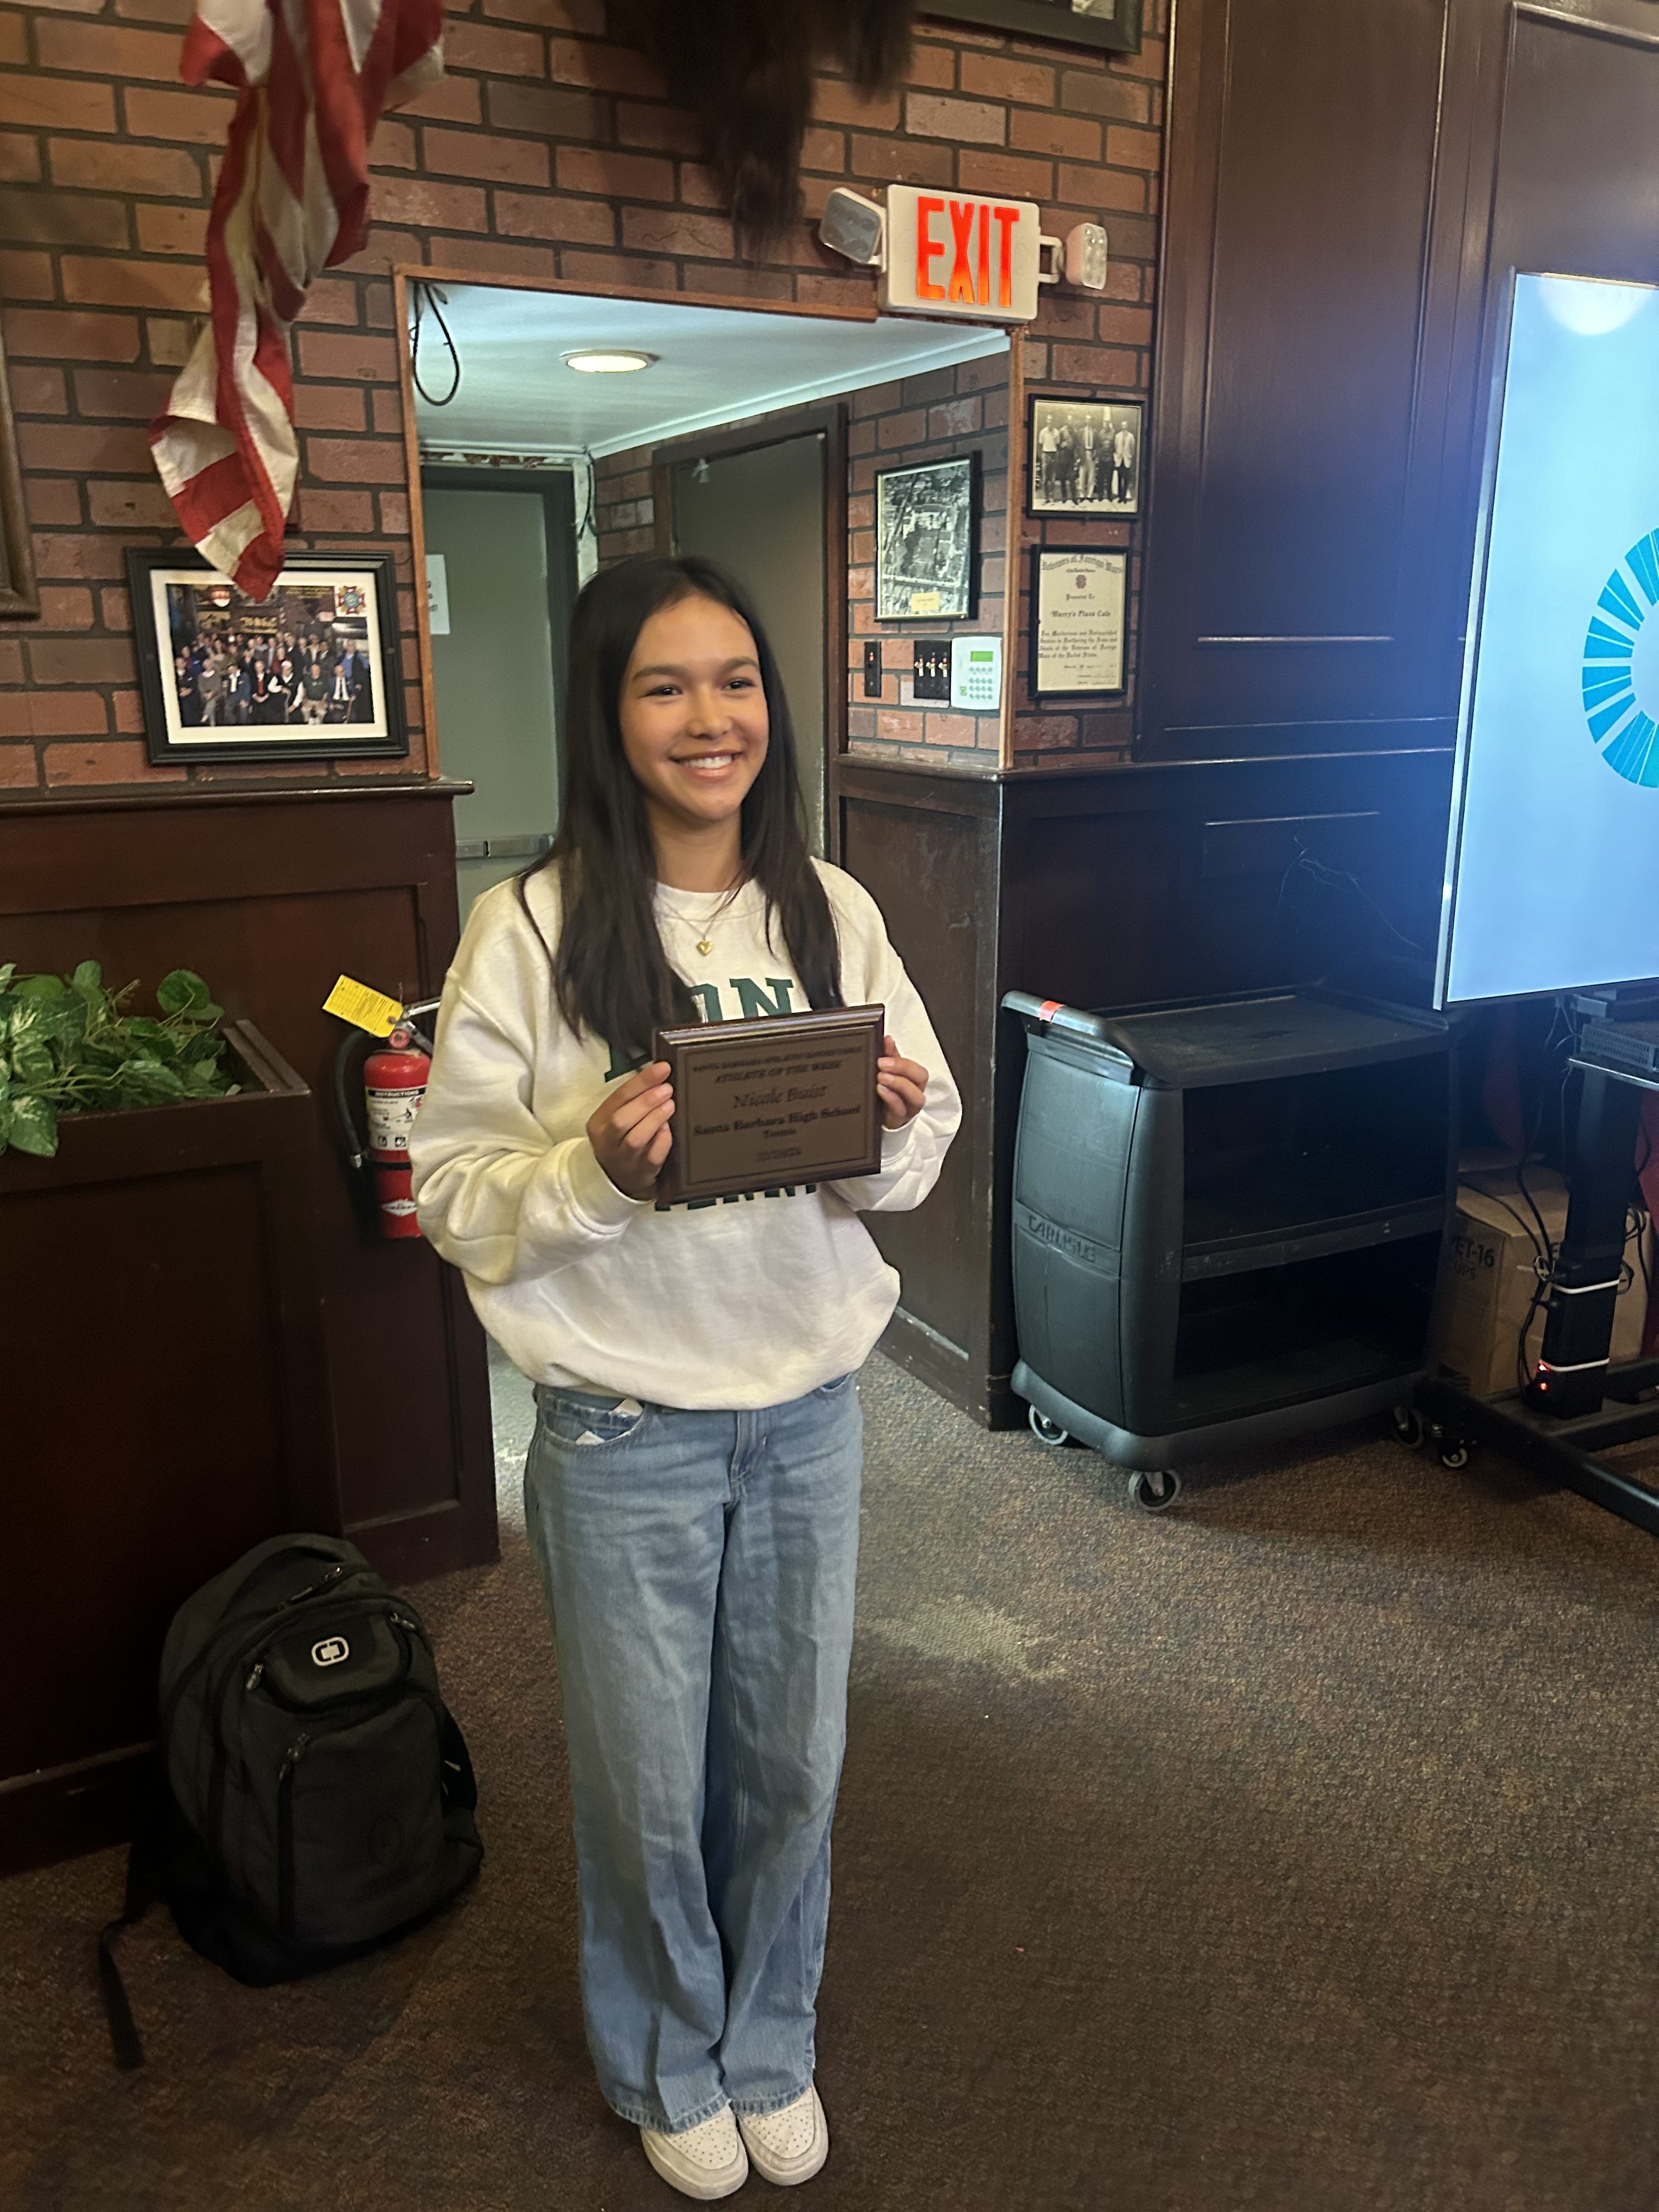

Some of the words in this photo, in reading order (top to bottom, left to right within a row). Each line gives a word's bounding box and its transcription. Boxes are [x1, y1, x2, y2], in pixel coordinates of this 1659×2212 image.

[916, 196, 1020, 308] EXIT
[733, 1114, 785, 1130] Barbara
[788, 1110, 817, 1125] High
[1029, 1214, 1096, 1263] CARLISLE
